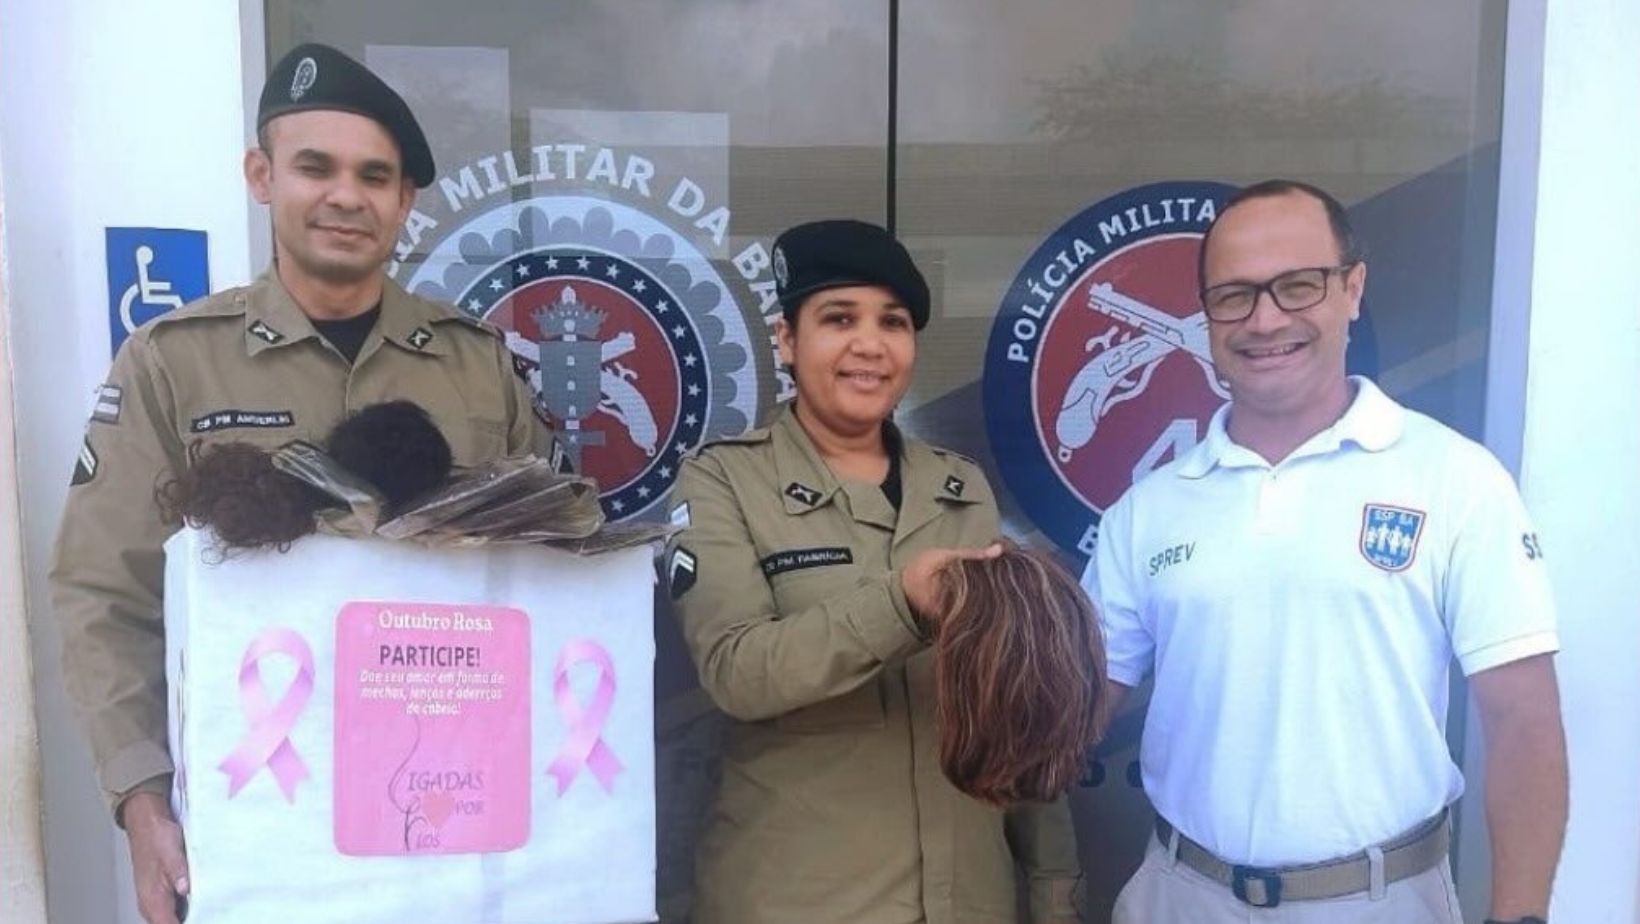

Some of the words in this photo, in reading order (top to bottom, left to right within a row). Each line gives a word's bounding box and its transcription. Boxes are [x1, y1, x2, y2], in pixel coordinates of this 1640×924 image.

[438, 143, 655, 212] MILITAR
[667, 177, 730, 245] DA
[1007, 242, 1098, 362] POLÍCIA
[1149, 541, 1196, 576] SPREV
[379, 610, 450, 630] Outubro
[452, 612, 493, 631] Rosa
[380, 645, 480, 667] PARTICIPE!
[385, 672, 404, 683] seu
[406, 672, 433, 683] amor
[437, 673, 454, 683] em
[455, 671, 488, 687] forma
[490, 672, 505, 684] de
[406, 702, 419, 714] de
